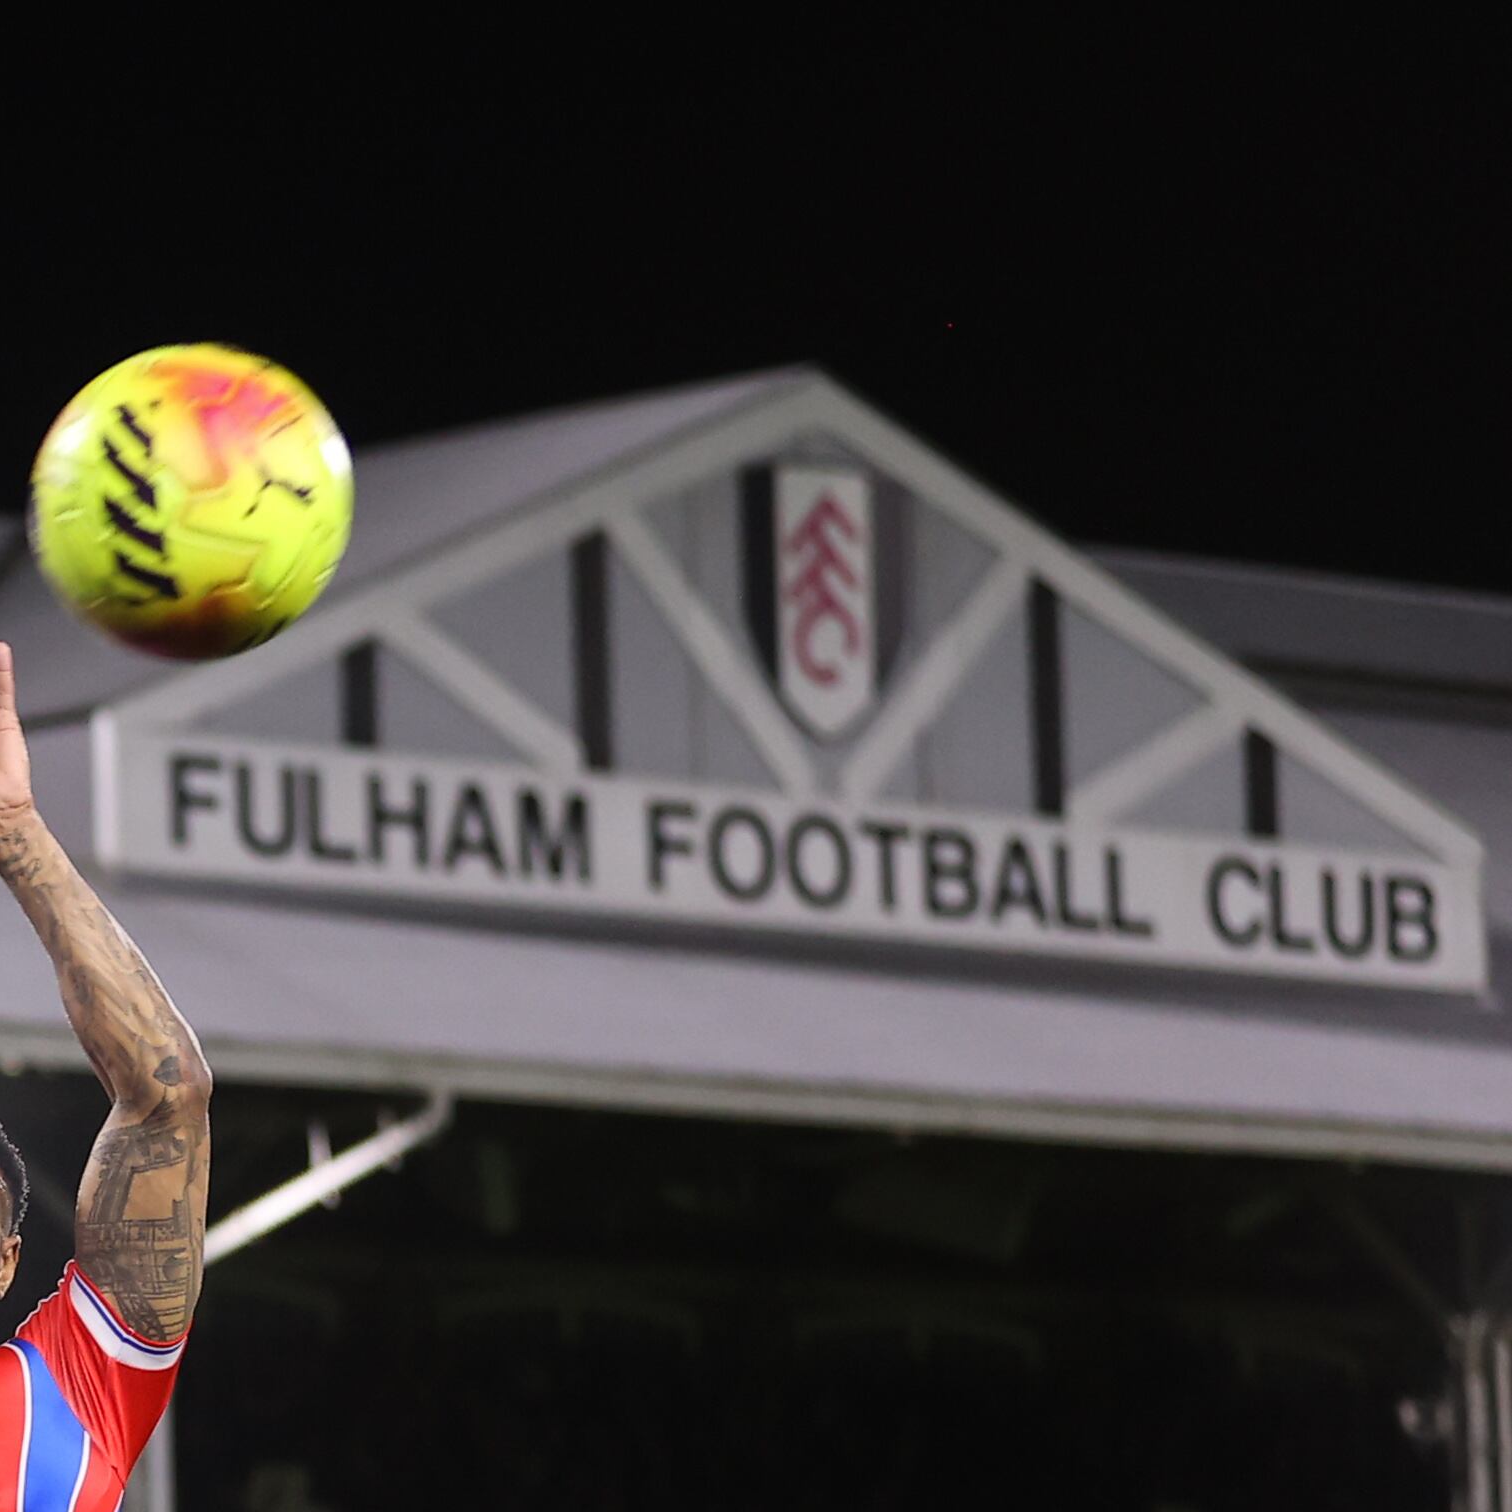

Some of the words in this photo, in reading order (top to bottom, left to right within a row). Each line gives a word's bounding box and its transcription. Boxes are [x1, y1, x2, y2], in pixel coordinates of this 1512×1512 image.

[167, 751, 593, 884] FULHAM
[645, 799, 1156, 940] FOOTBALL
[1205, 854, 1439, 965] CLUB
